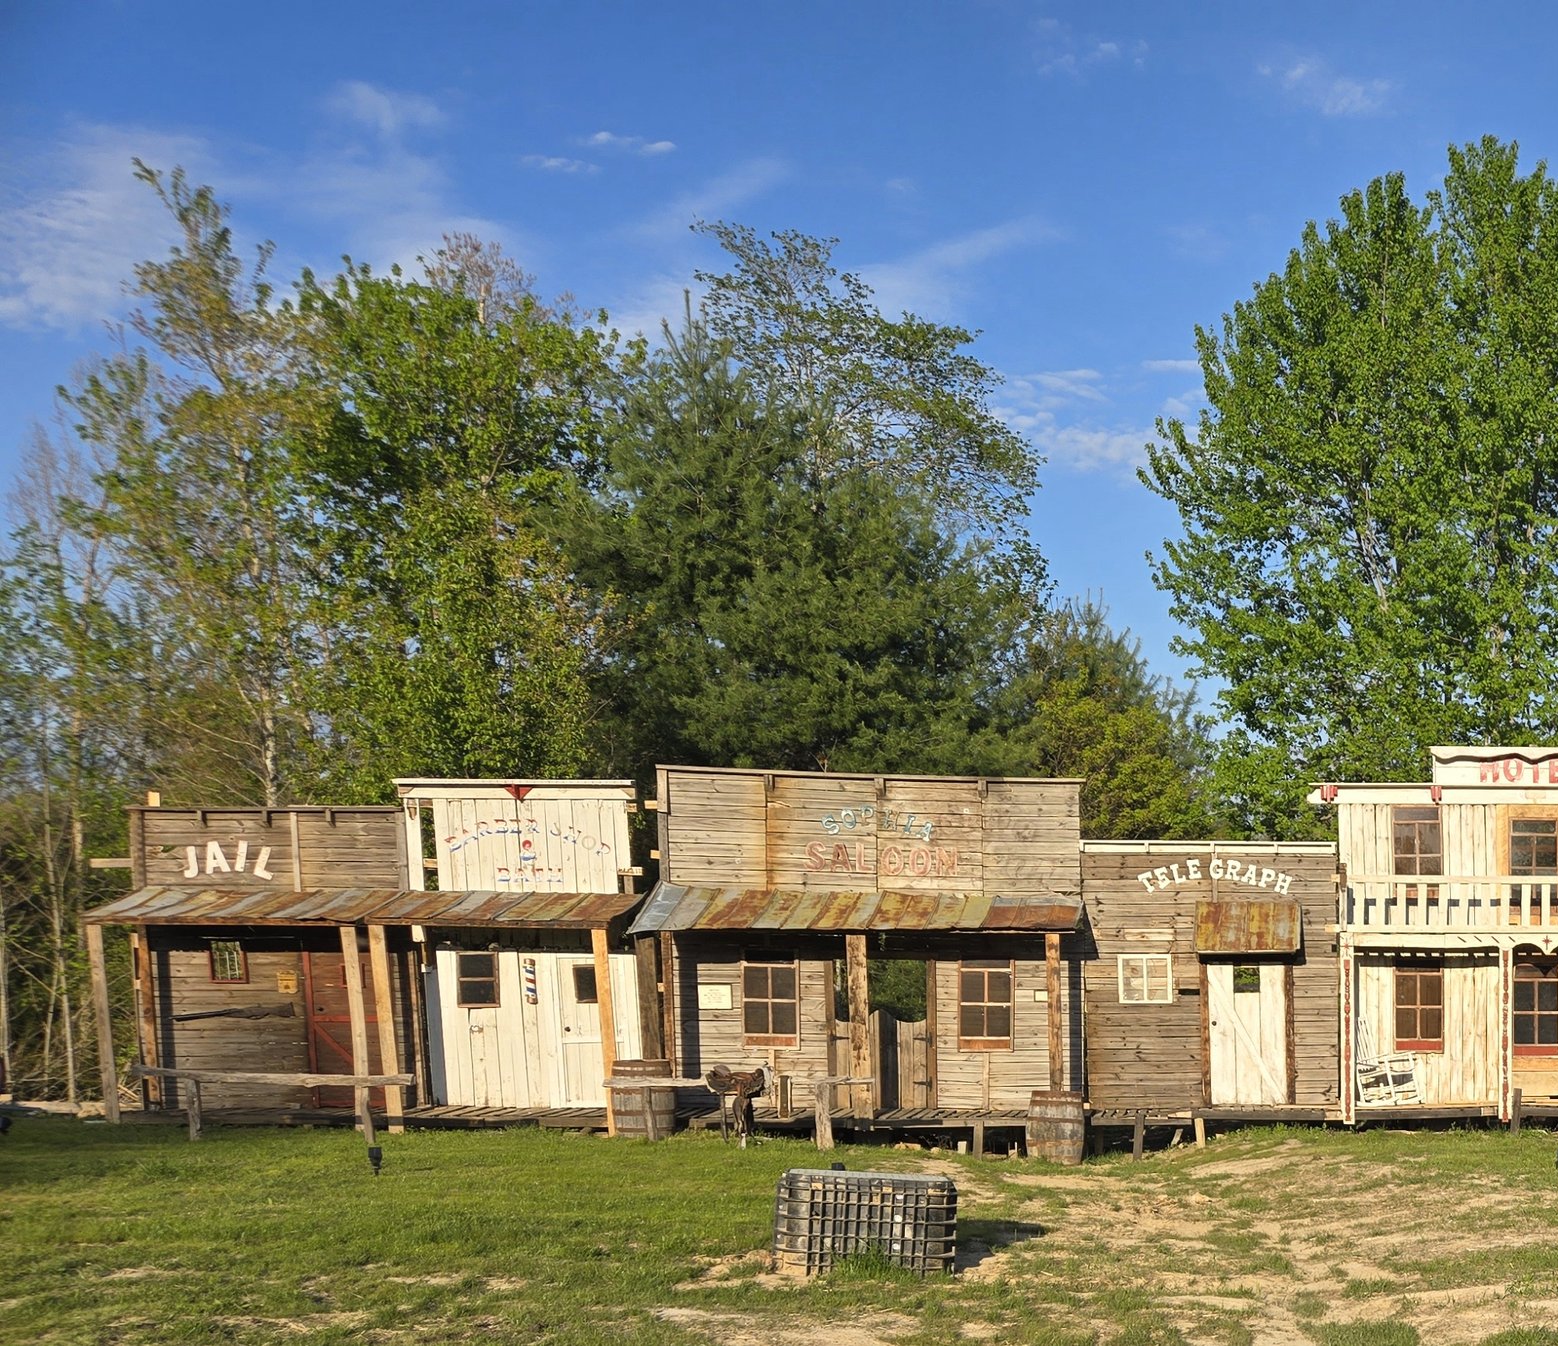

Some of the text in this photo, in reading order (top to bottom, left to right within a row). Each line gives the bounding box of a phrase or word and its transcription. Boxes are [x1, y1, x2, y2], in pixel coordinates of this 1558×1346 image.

[820, 805, 934, 842] SOPHIA
[183, 840, 275, 881] JAIL
[803, 840, 961, 877] SALOON
